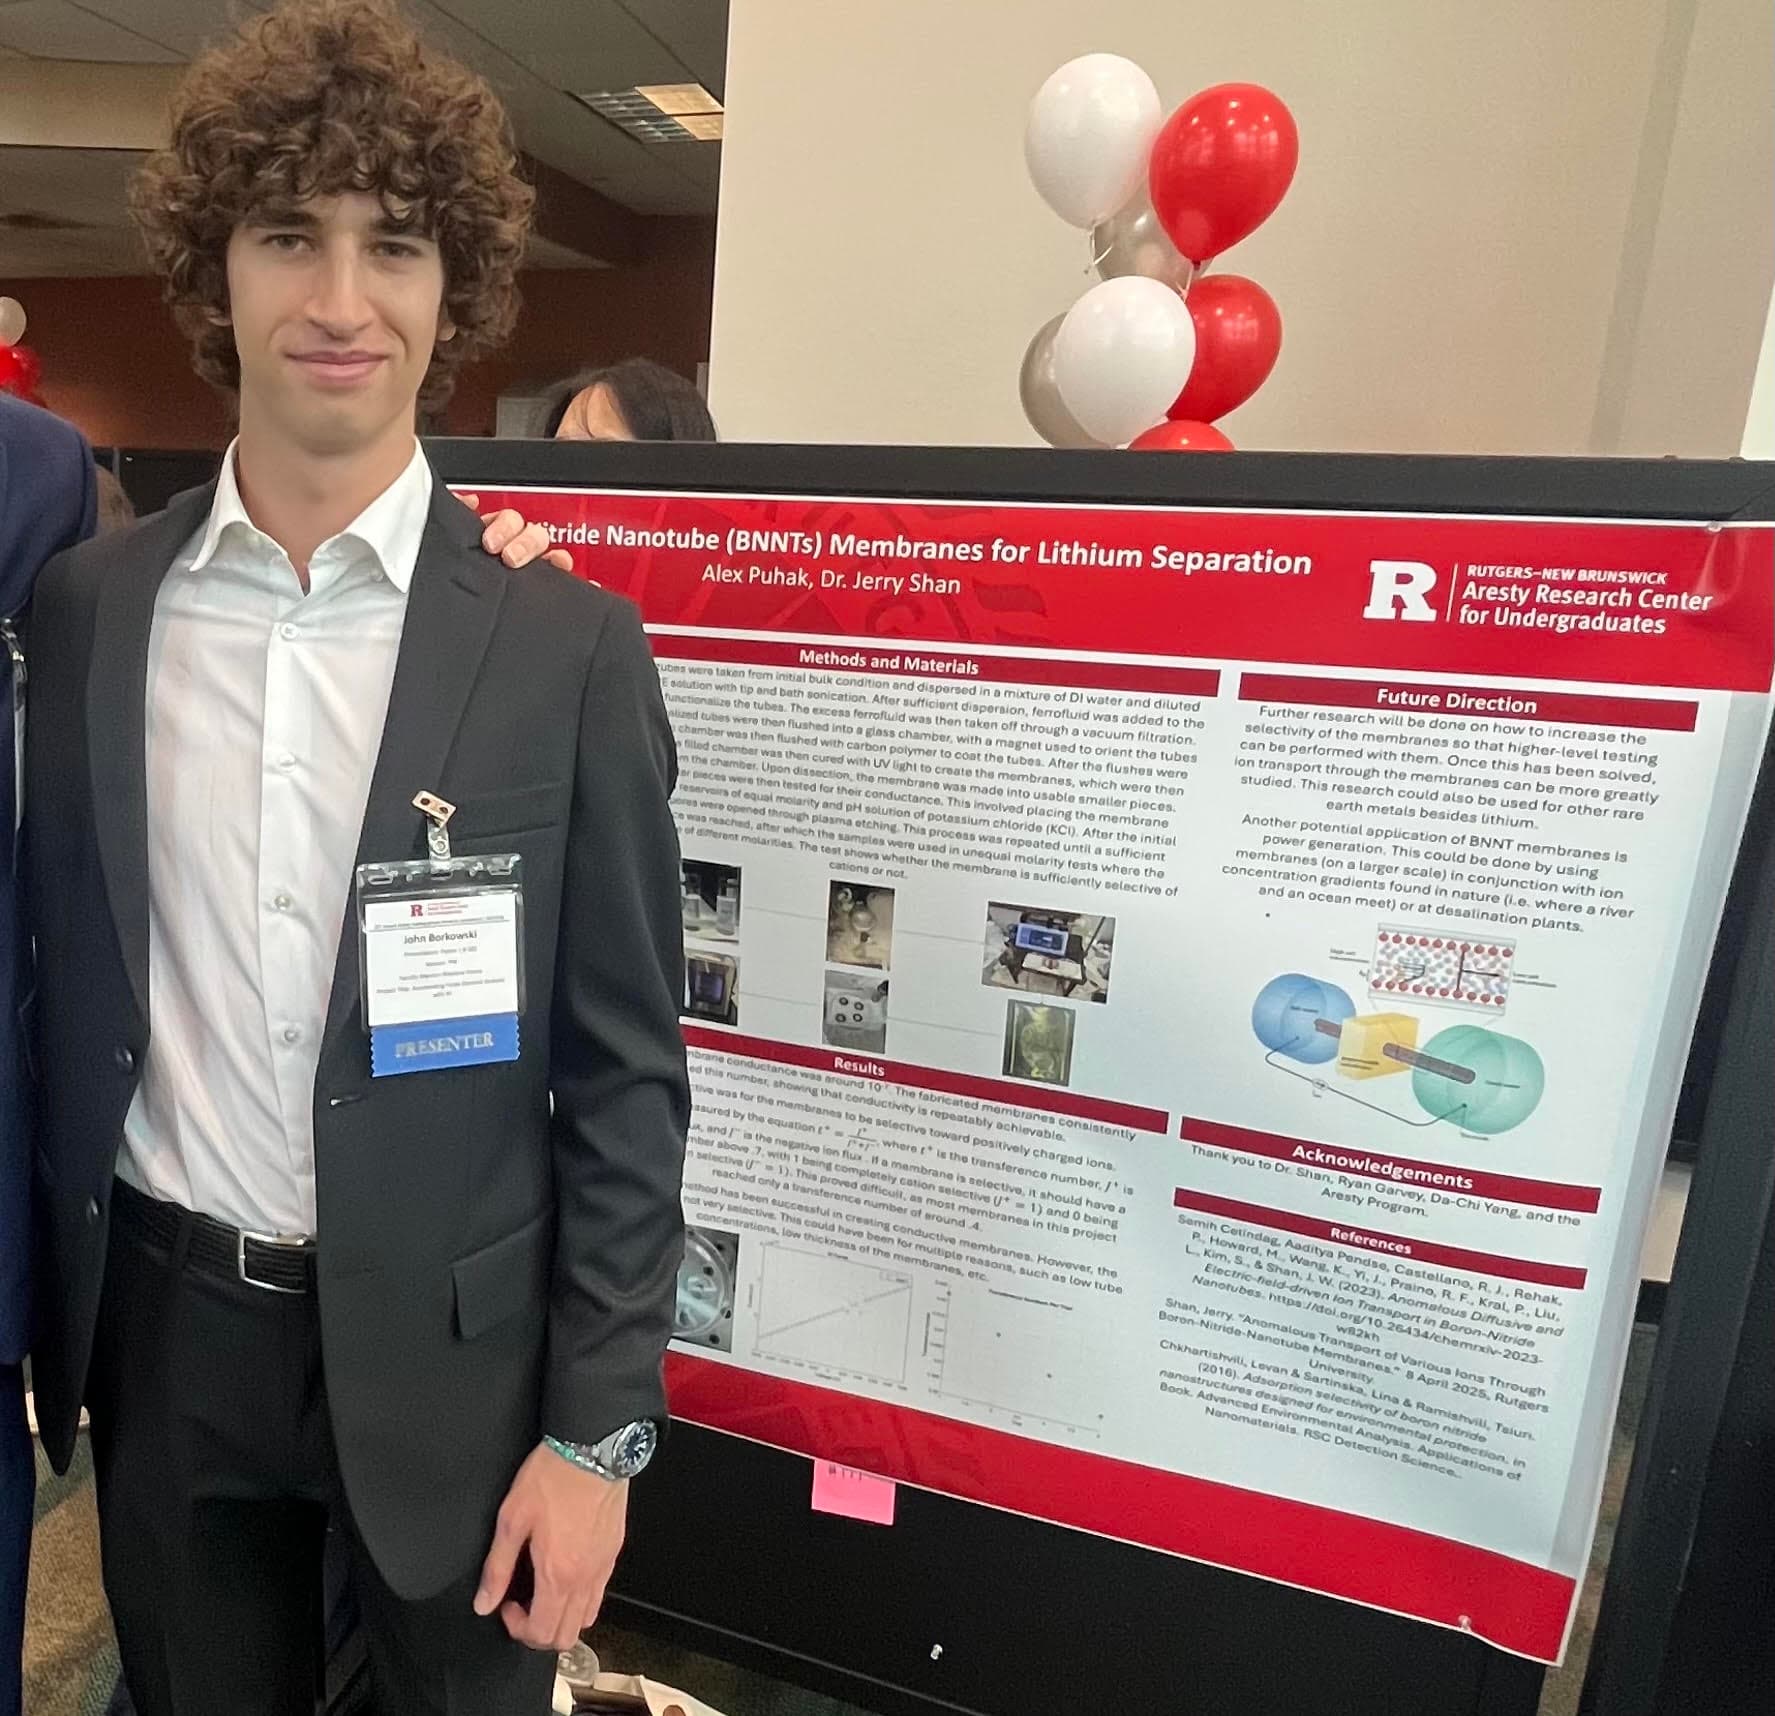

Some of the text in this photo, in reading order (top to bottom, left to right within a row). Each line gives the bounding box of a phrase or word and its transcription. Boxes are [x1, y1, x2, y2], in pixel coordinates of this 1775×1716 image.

[606, 525, 720, 550] Nanotube
[726, 528, 822, 557] (BNNTs)
[829, 534, 983, 561] Membranes
[991, 538, 1031, 563] for
[1037, 541, 1142, 568] Lithium
[1151, 546, 1312, 575] Separation
[701, 564, 961, 595] Alex Puhak, Dr. Jerry Shan
[1363, 560, 1437, 621] R
[1577, 569, 1668, 584] BRUNSWICK
[1462, 582, 1714, 611] Aresty Research Center
[1459, 605, 1667, 633] for Undergraduates
[799, 649, 980, 676] Methods and Materials
[1376, 689, 1537, 714] Future Direction
[1259, 705, 1647, 745] Further research will be done on how to increase the
[1244, 722, 1659, 767] selectivity of the membranes so that higher-level testing
[1239, 740, 1657, 784] can be performed with them. Once this has been solved,
[1234, 758, 1659, 805] ion transport through the membranes can be more greatly
[1240, 773, 1644, 820] studied. This research could also be used for other rare
[1325, 798, 1538, 829] earth metals besides lithium.
[1241, 813, 1628, 862] Another potential application of BNNT membranes is
[828, 860, 869, 874] cations
[871, 866, 883, 876] or
[1262, 834, 1599, 880] power generation. This could be done by using
[410, 904, 423, 917] R
[1258, 884, 1584, 933] and an ocean meet) or at desalination plants.
[395, 1032, 494, 1058] PRESENTER
[834, 1056, 885, 1077] Results
[1292, 1145, 1473, 1189] Acknowledgements
[1191, 1144, 1229, 1160] Thank
[1231, 1155, 1255, 1168] you
[1257, 1159, 1271, 1170] to
[1337, 1174, 1371, 1191] Ryan
[1430, 1190, 1481, 1209] Da-Chi
[1525, 1208, 1554, 1222] and
[1556, 1214, 1581, 1227] the
[1320, 1186, 1430, 1219] Aresty Program.
[1330, 1227, 1412, 1254] References
[1307, 1358, 1373, 1386] University
